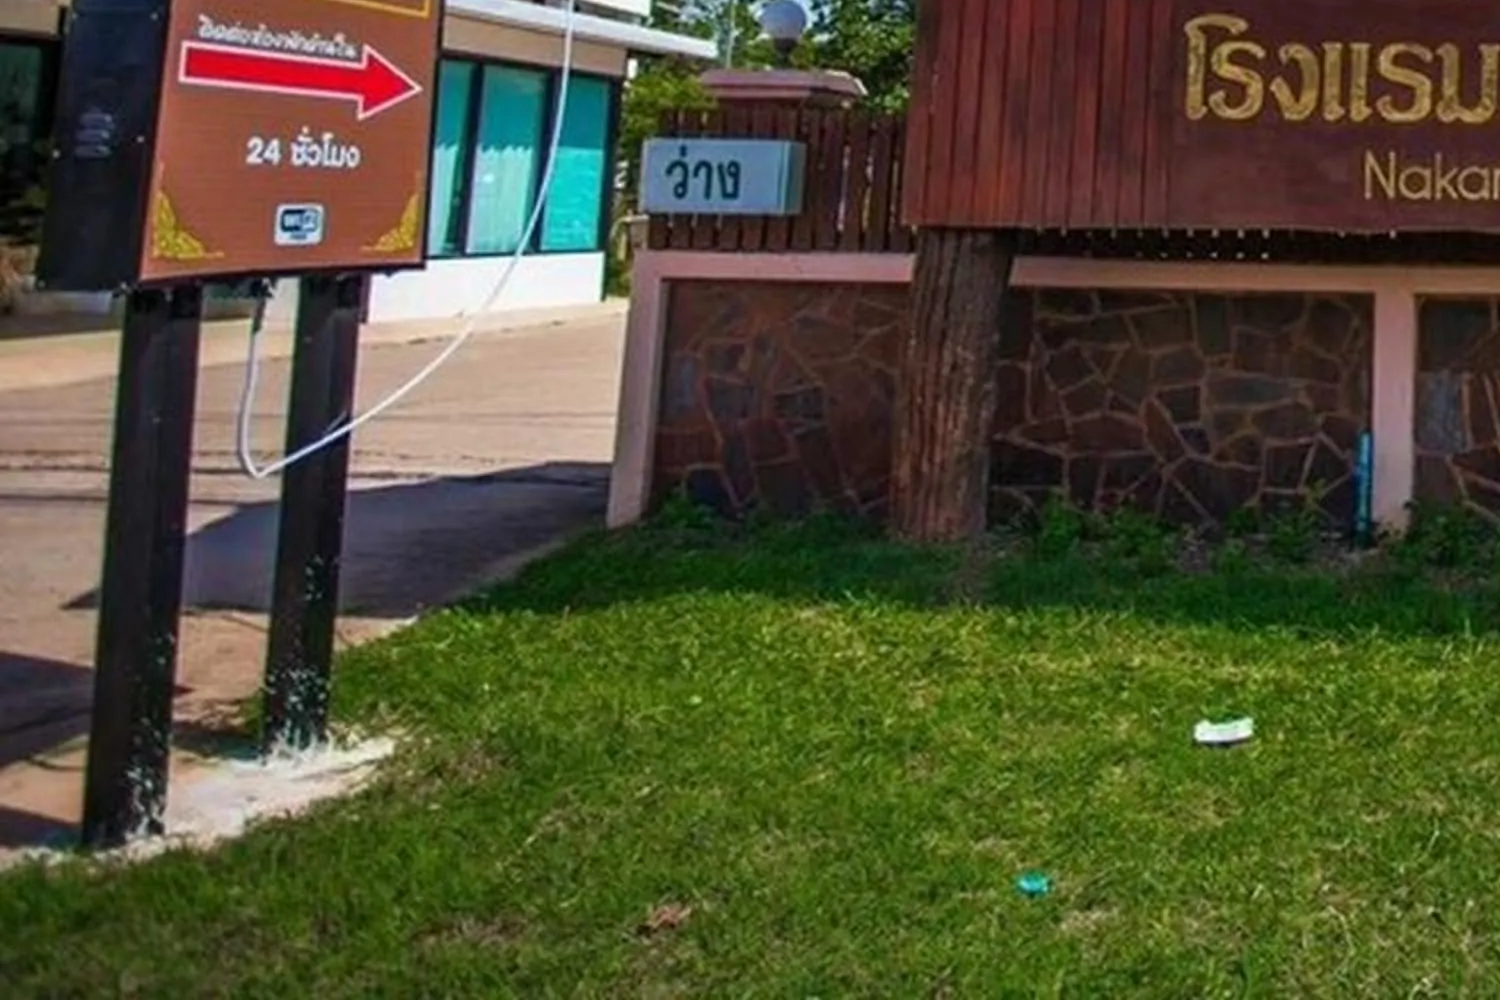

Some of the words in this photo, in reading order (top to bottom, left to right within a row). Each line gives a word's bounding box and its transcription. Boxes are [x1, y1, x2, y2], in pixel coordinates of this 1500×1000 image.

[246, 136, 281, 165] 24
[290, 125, 361, 169] ชั่วโมง
[665, 144, 741, 200] ว่าง
